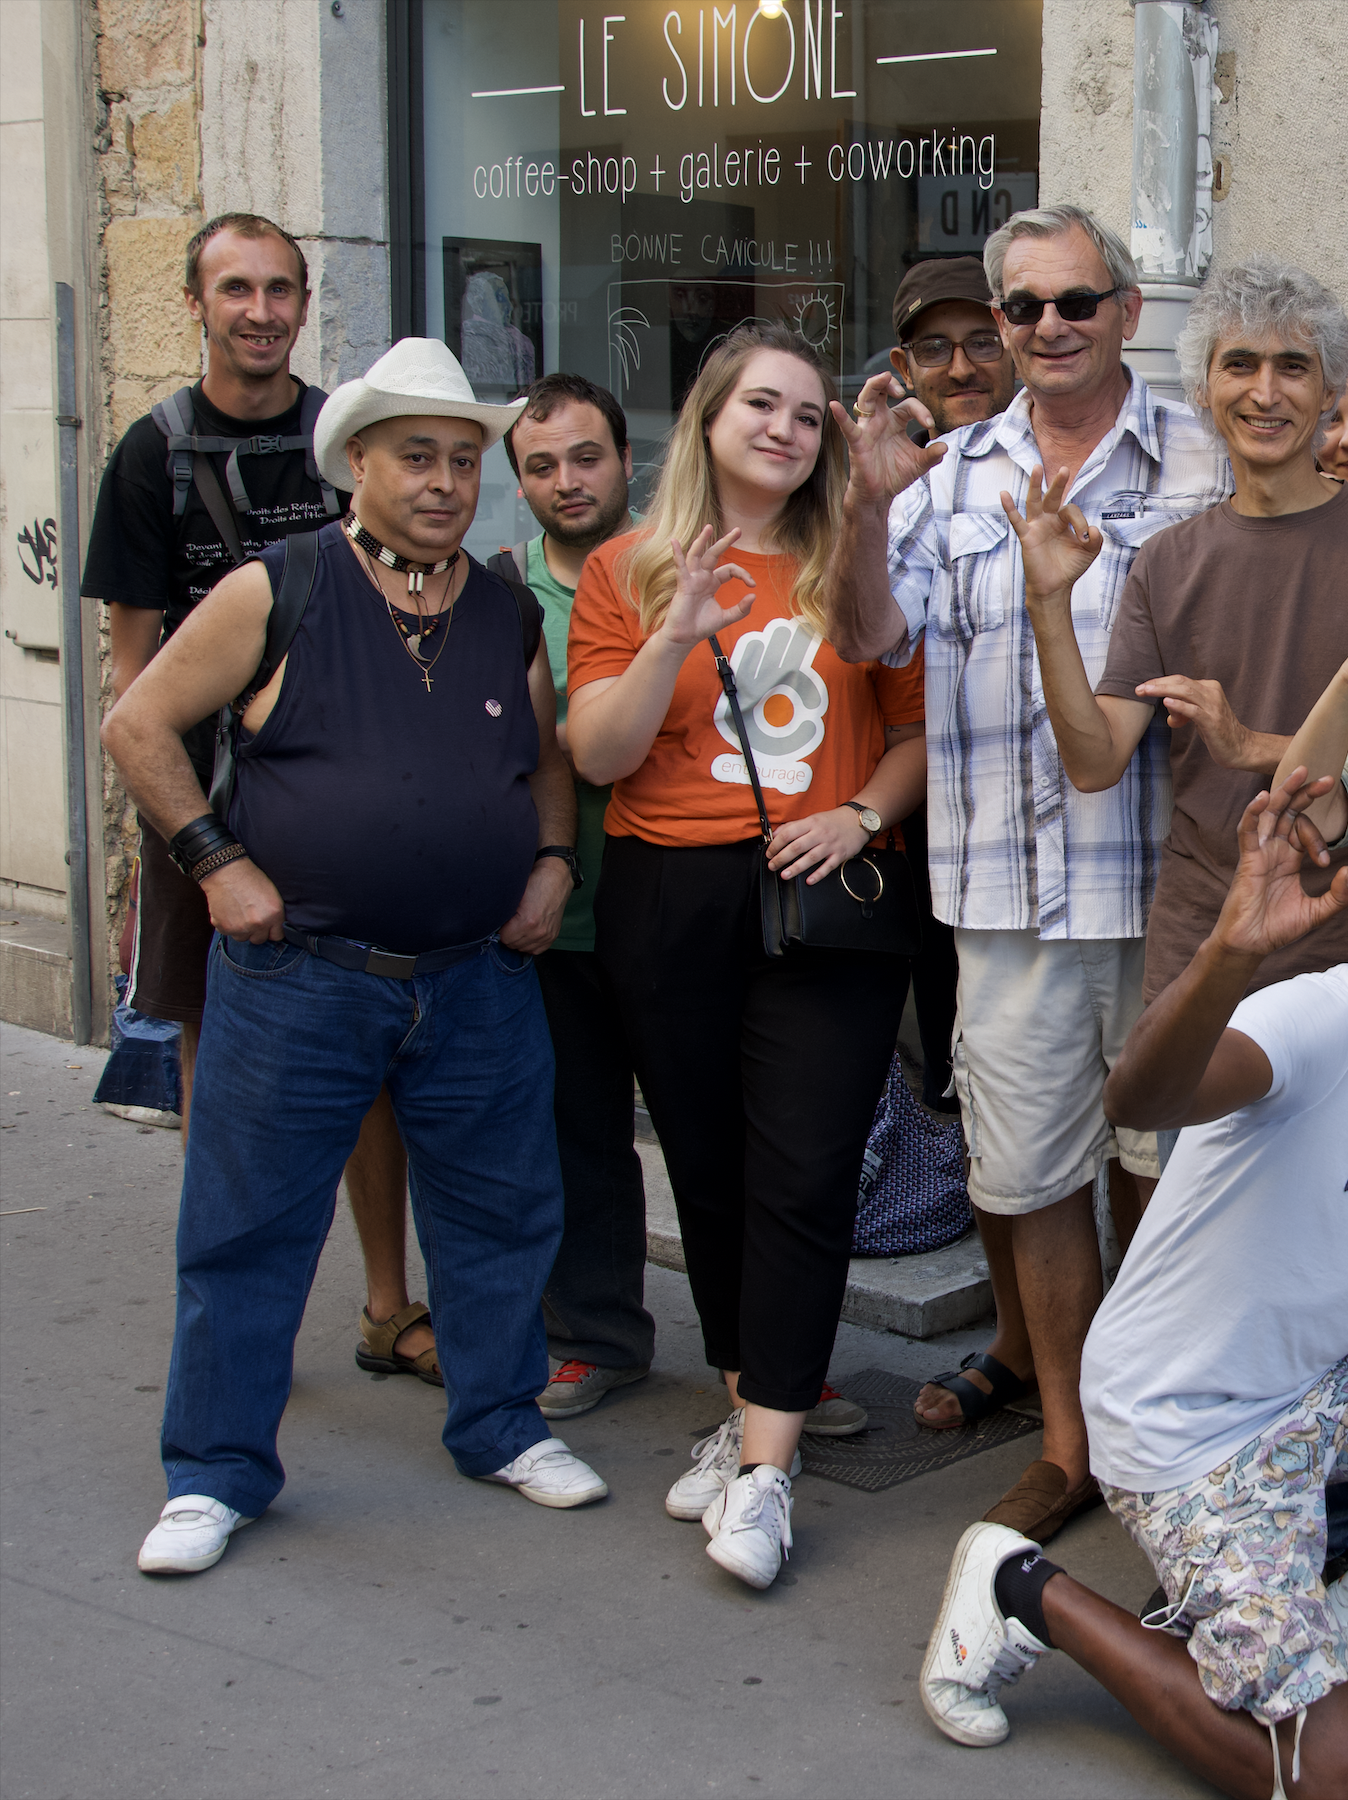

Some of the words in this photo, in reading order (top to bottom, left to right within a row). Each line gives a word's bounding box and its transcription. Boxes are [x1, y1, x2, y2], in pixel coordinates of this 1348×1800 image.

[579, 15, 628, 117] LE
[662, 0, 857, 111] SIMONE
[473, 151, 637, 204] coffee-shop
[650, 154, 666, 192] +
[679, 139, 781, 204] galerie
[794, 145, 812, 185] +
[828, 126, 995, 190] coworking
[611, 233, 683, 264] BONNE
[259, 515, 288, 525] Droits
[289, 512, 302, 521] de
[303, 510, 324, 520] l'Ho
